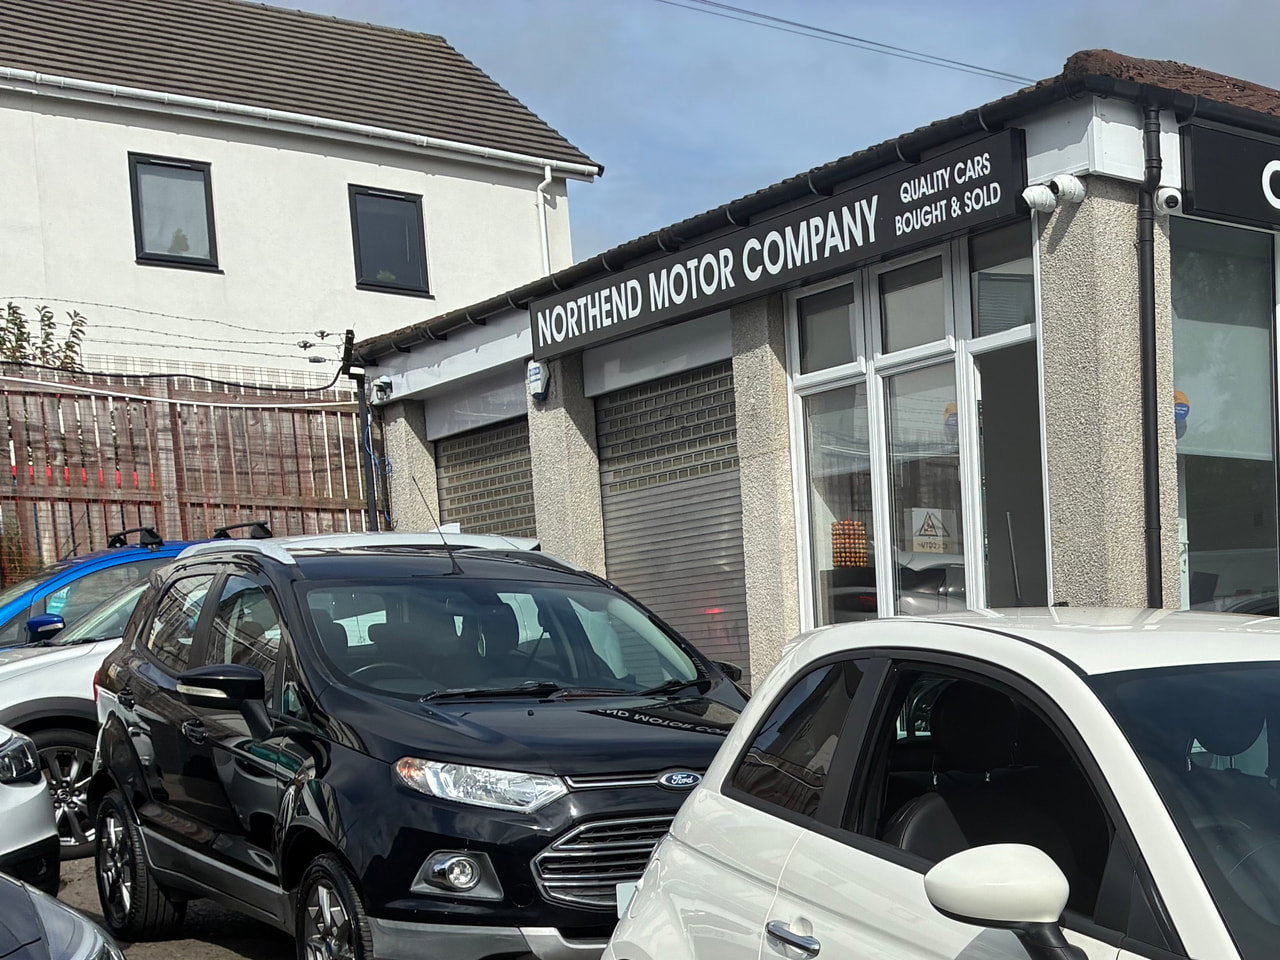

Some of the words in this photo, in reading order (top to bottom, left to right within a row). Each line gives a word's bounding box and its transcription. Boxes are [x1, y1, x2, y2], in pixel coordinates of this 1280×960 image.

[900, 166, 951, 204] QUALITY
[953, 152, 992, 189] CARS
[894, 202, 948, 237] BOUGHT
[949, 199, 963, 219] &
[963, 182, 1002, 213] SOLD
[537, 278, 642, 347] NORTHEND
[648, 247, 736, 312] MOTOR
[742, 195, 879, 282] COMPANY
[671, 774, 694, 785] Ford
